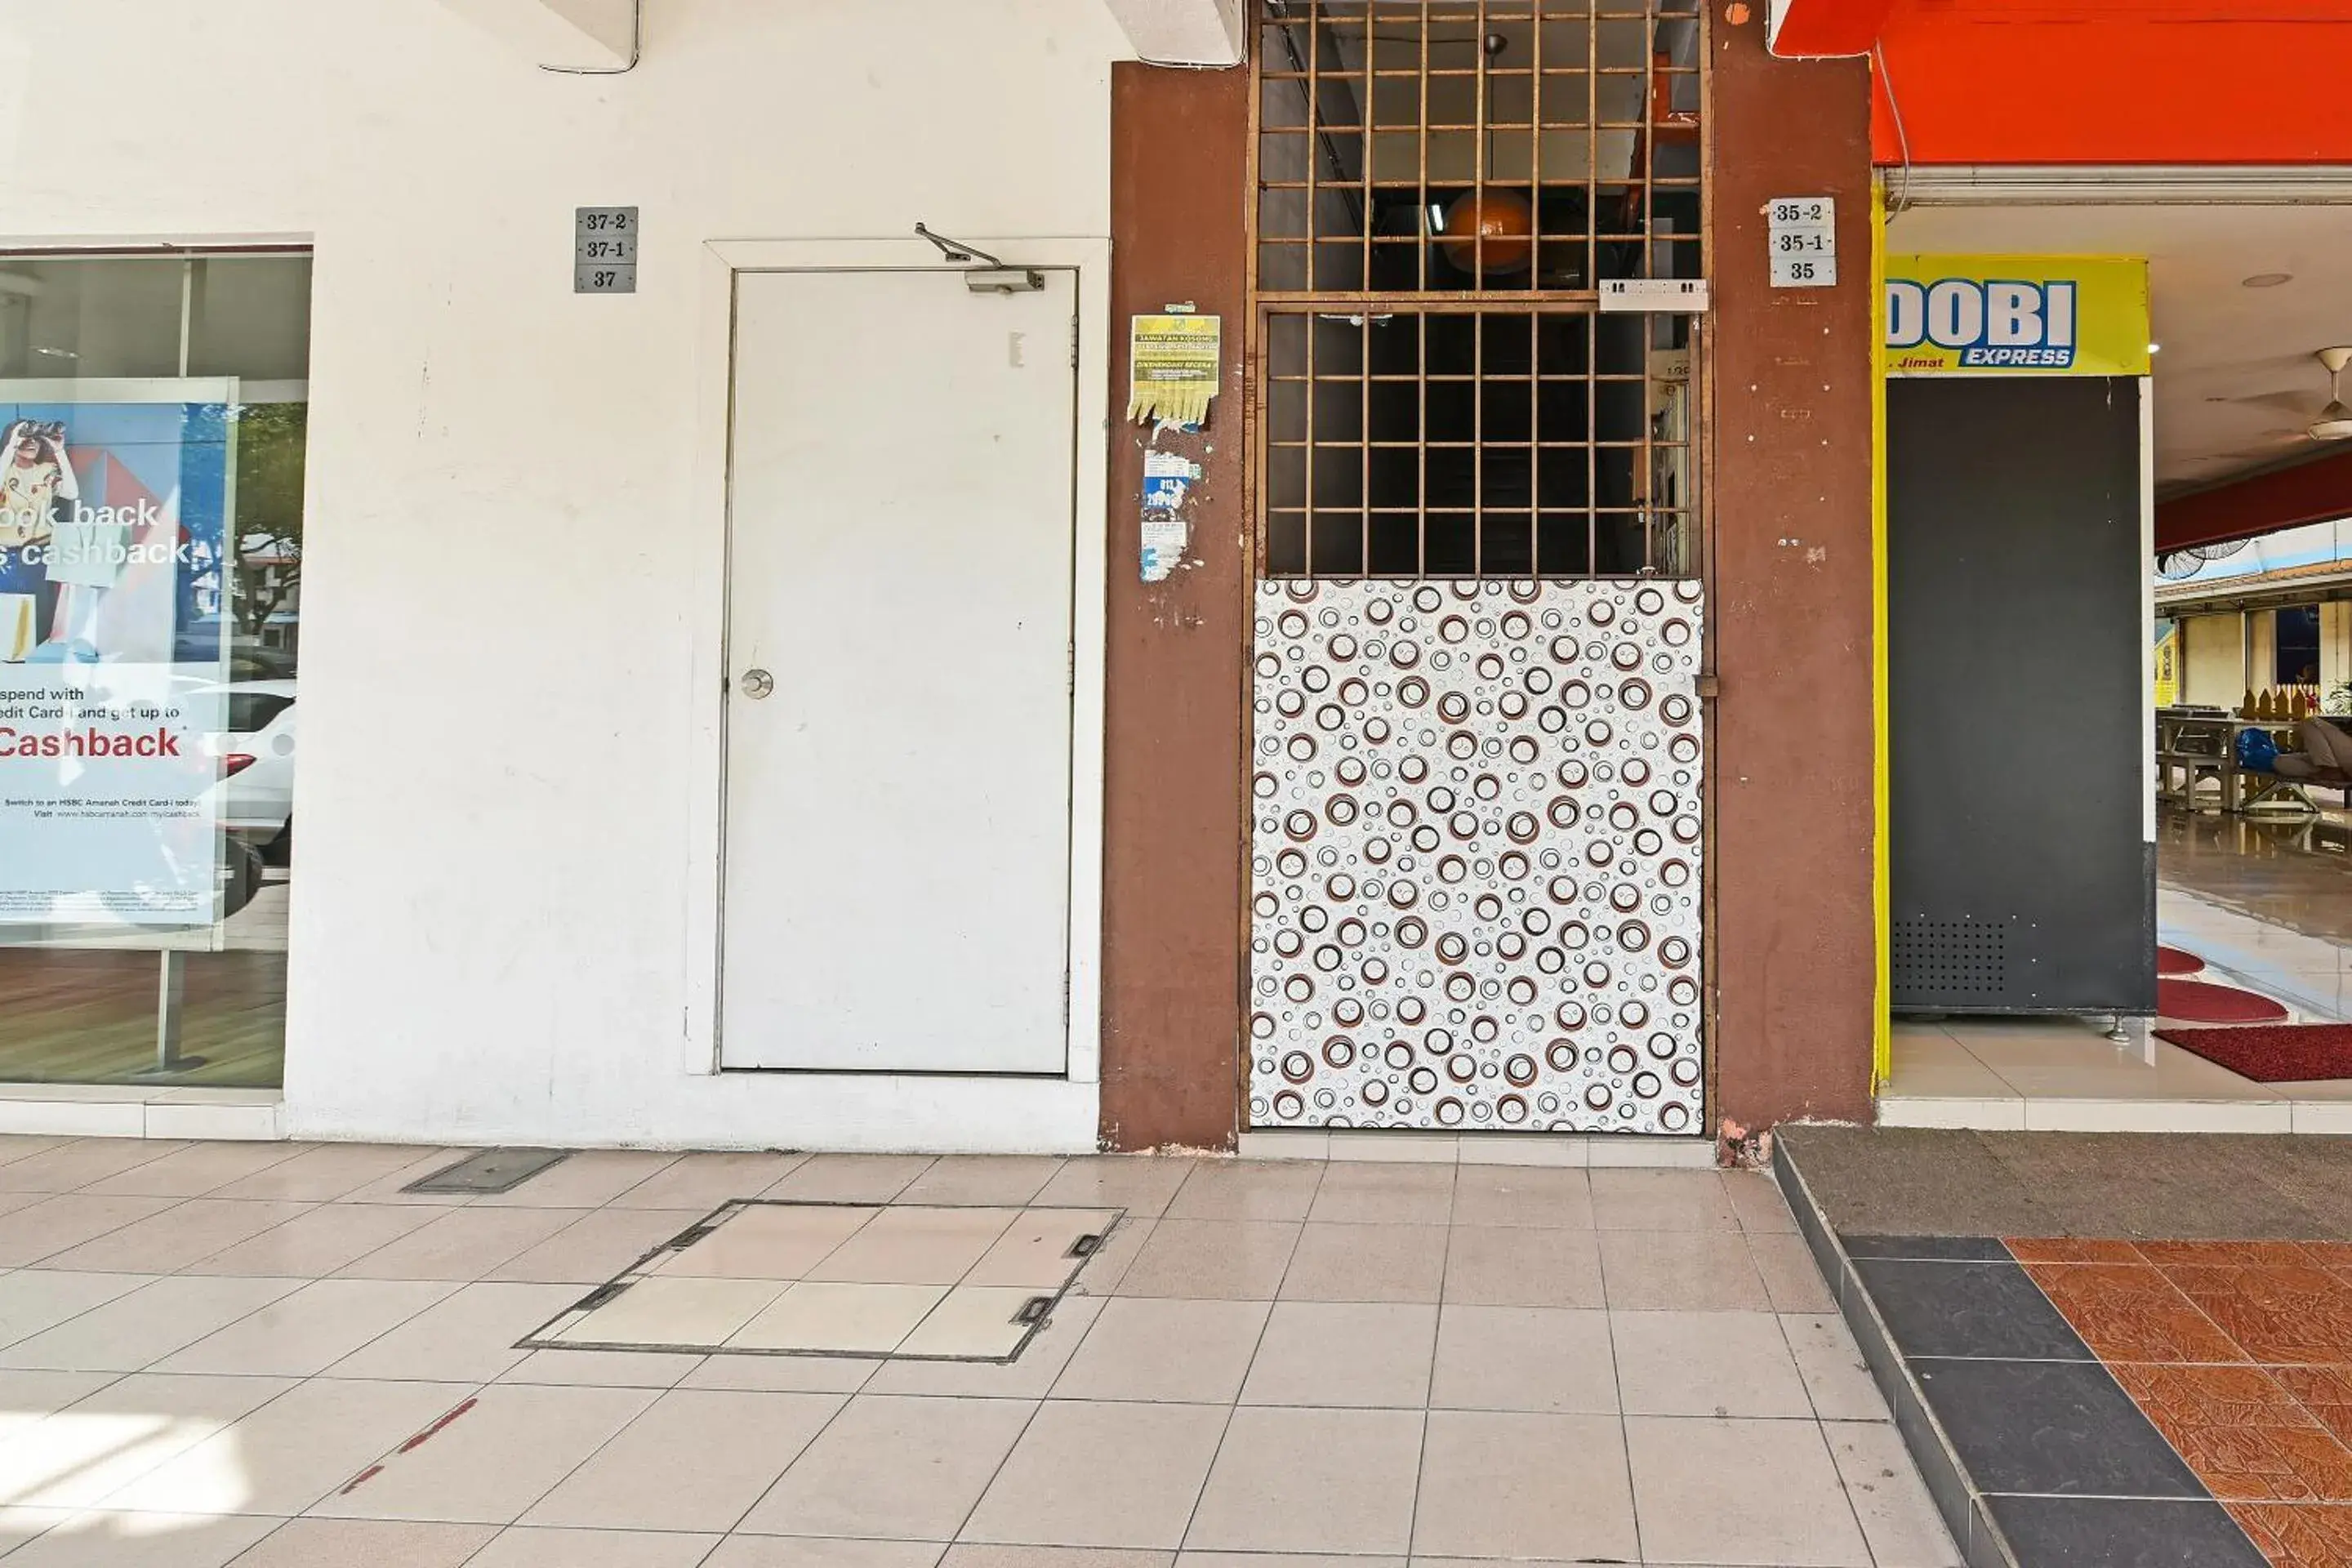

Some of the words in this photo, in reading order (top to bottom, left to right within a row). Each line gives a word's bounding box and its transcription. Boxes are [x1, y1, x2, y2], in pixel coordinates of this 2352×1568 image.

[587, 213, 626, 229] 37-2
[1777, 204, 1822, 221] 35-2
[587, 241, 625, 257] 37-1
[1780, 234, 1823, 252] 35-1
[594, 270, 616, 287] 37
[1791, 262, 1815, 279] 35
[1885, 278, 2076, 349] DOBI
[1898, 358, 1944, 368] Jimat
[1966, 348, 2070, 367] EXPRESS
[74, 499, 161, 527] back
[21, 535, 189, 565] cashback
[0, 687, 45, 702] spend
[50, 687, 84, 700] with
[78, 706, 105, 719] and
[110, 707, 136, 721] gt
[140, 708, 159, 720] up
[165, 707, 180, 718] to
[0, 726, 180, 756] Cashback
[59, 799, 83, 807] HSBC
